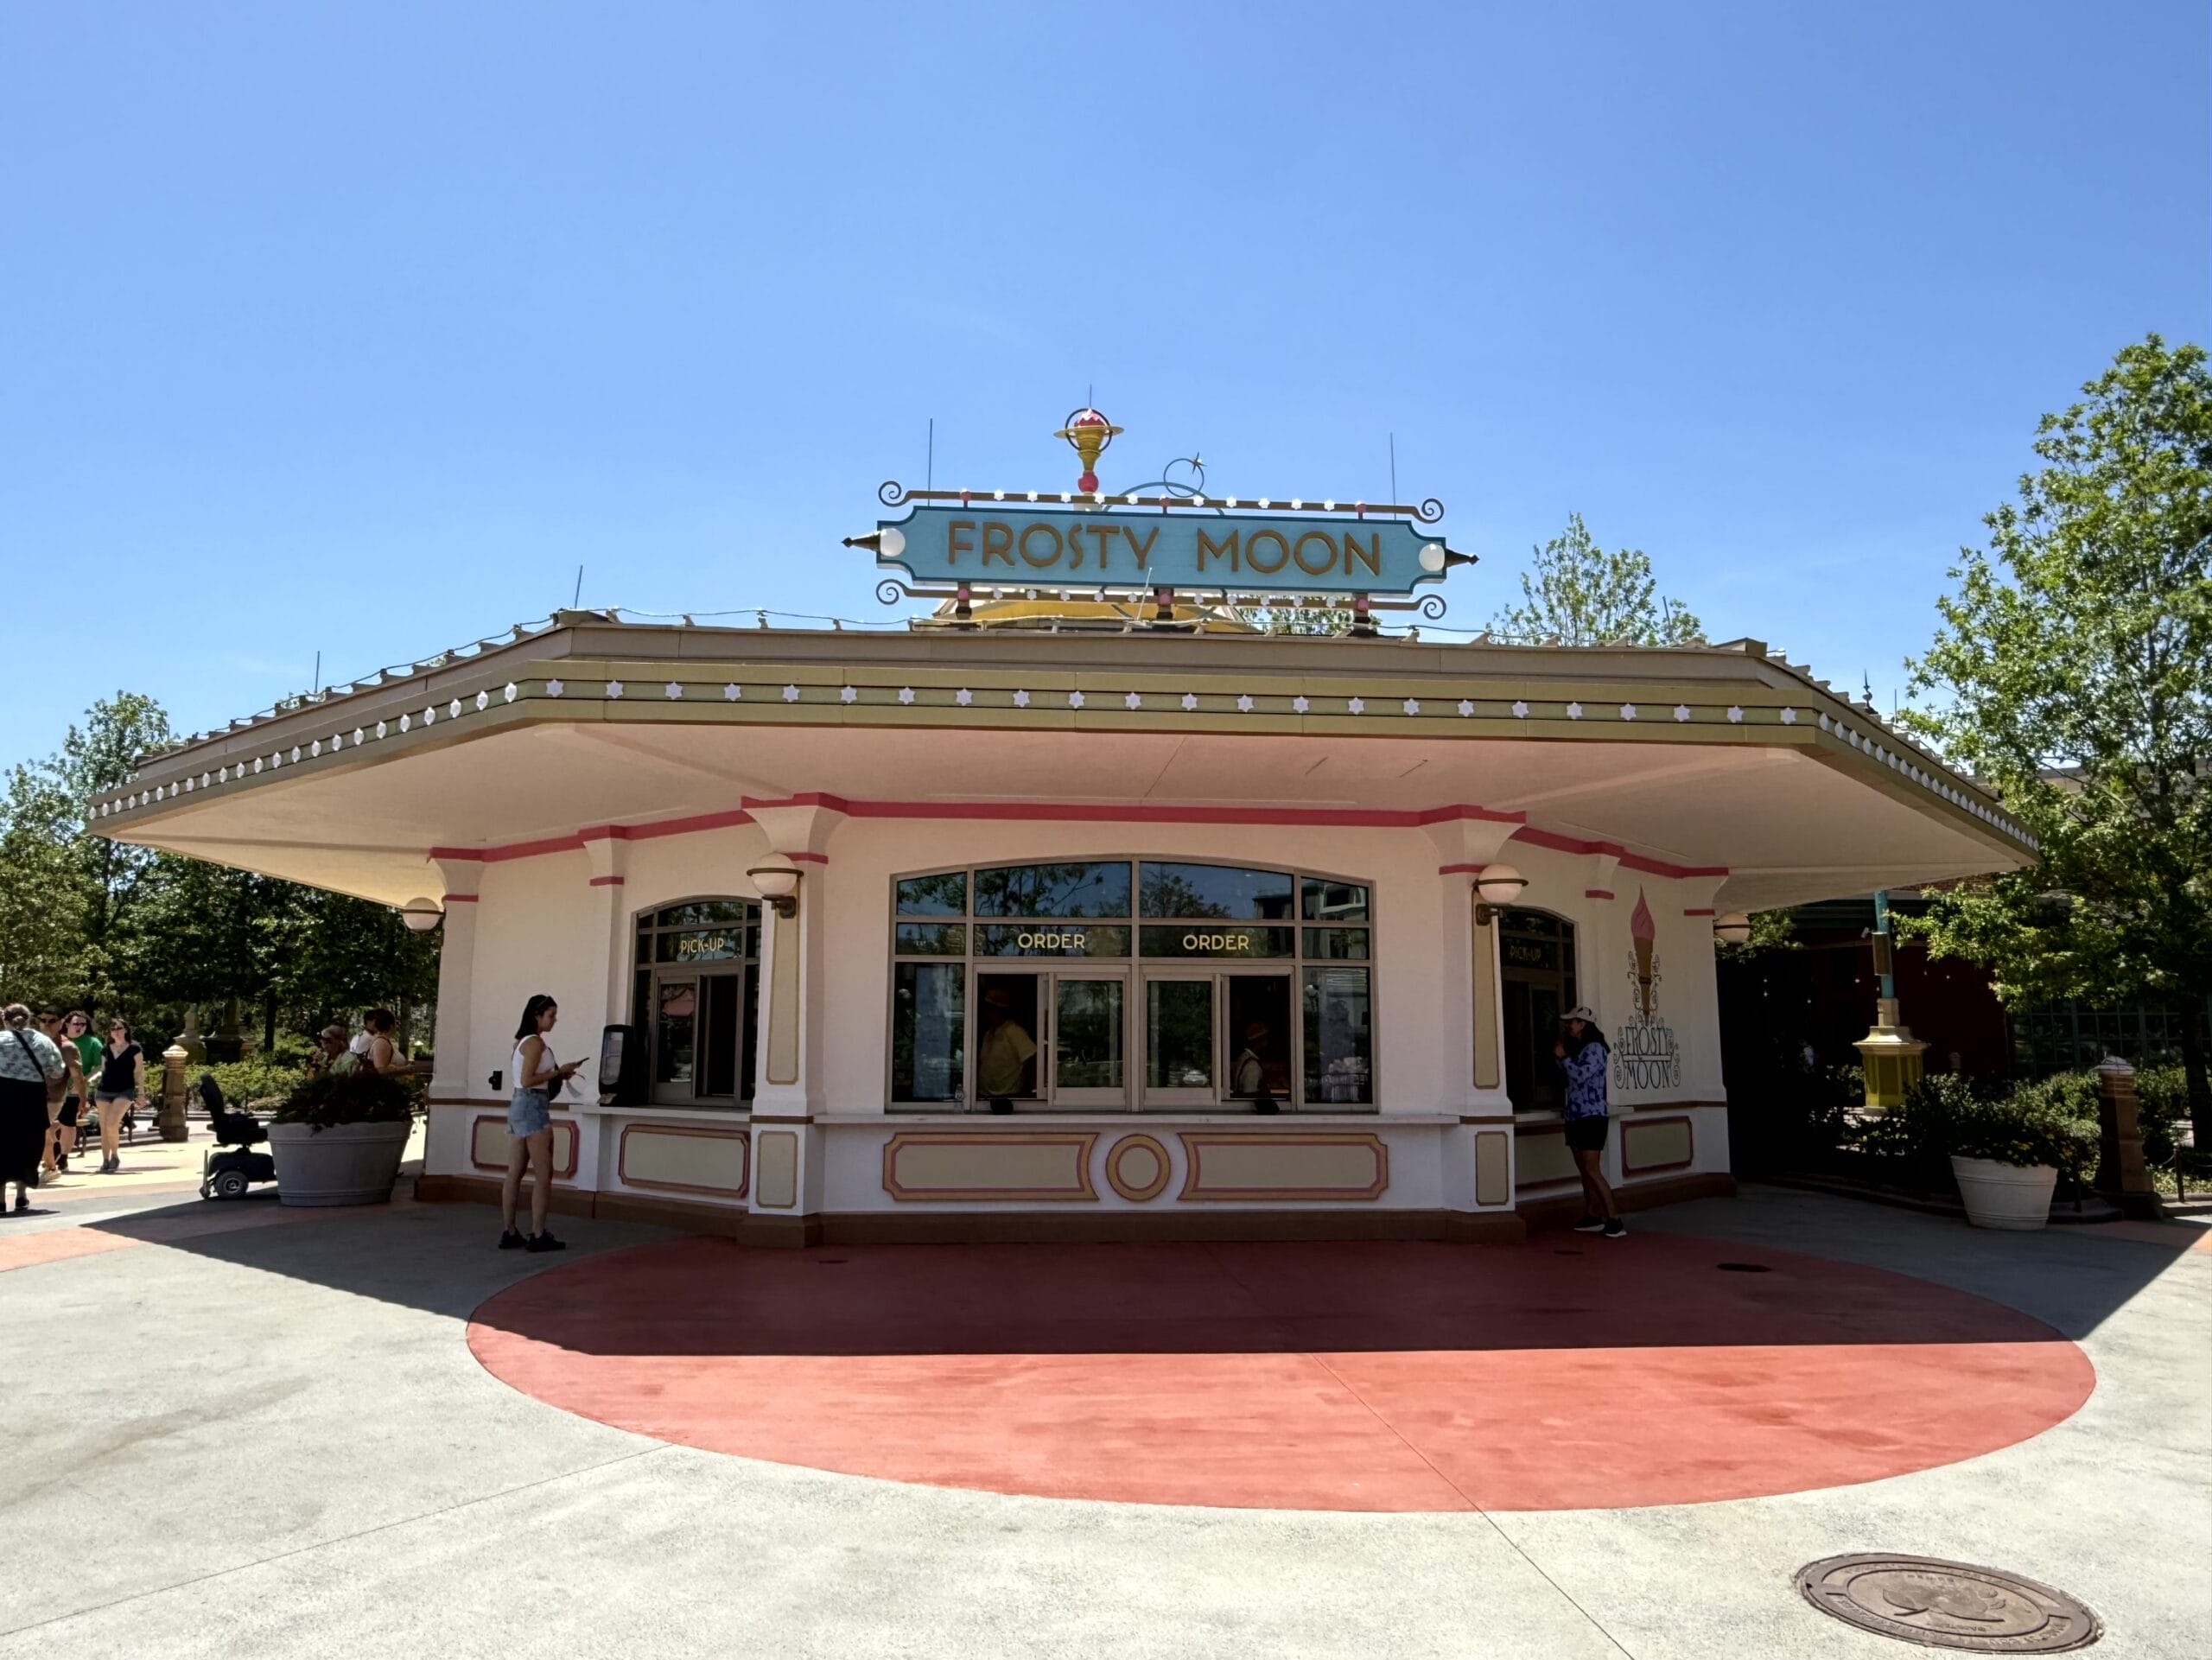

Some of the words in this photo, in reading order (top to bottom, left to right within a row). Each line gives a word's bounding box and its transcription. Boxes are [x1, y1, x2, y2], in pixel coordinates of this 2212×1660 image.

[947, 519, 1160, 571] FROSTY
[1197, 528, 1381, 577] MOON
[681, 937, 724, 954] PICK-UP
[1017, 933, 1085, 949] ORDER
[1182, 934, 1249, 951] ORDER
[1624, 1026, 1673, 1056] FROSTY
[1624, 1059, 1670, 1090] MOON
